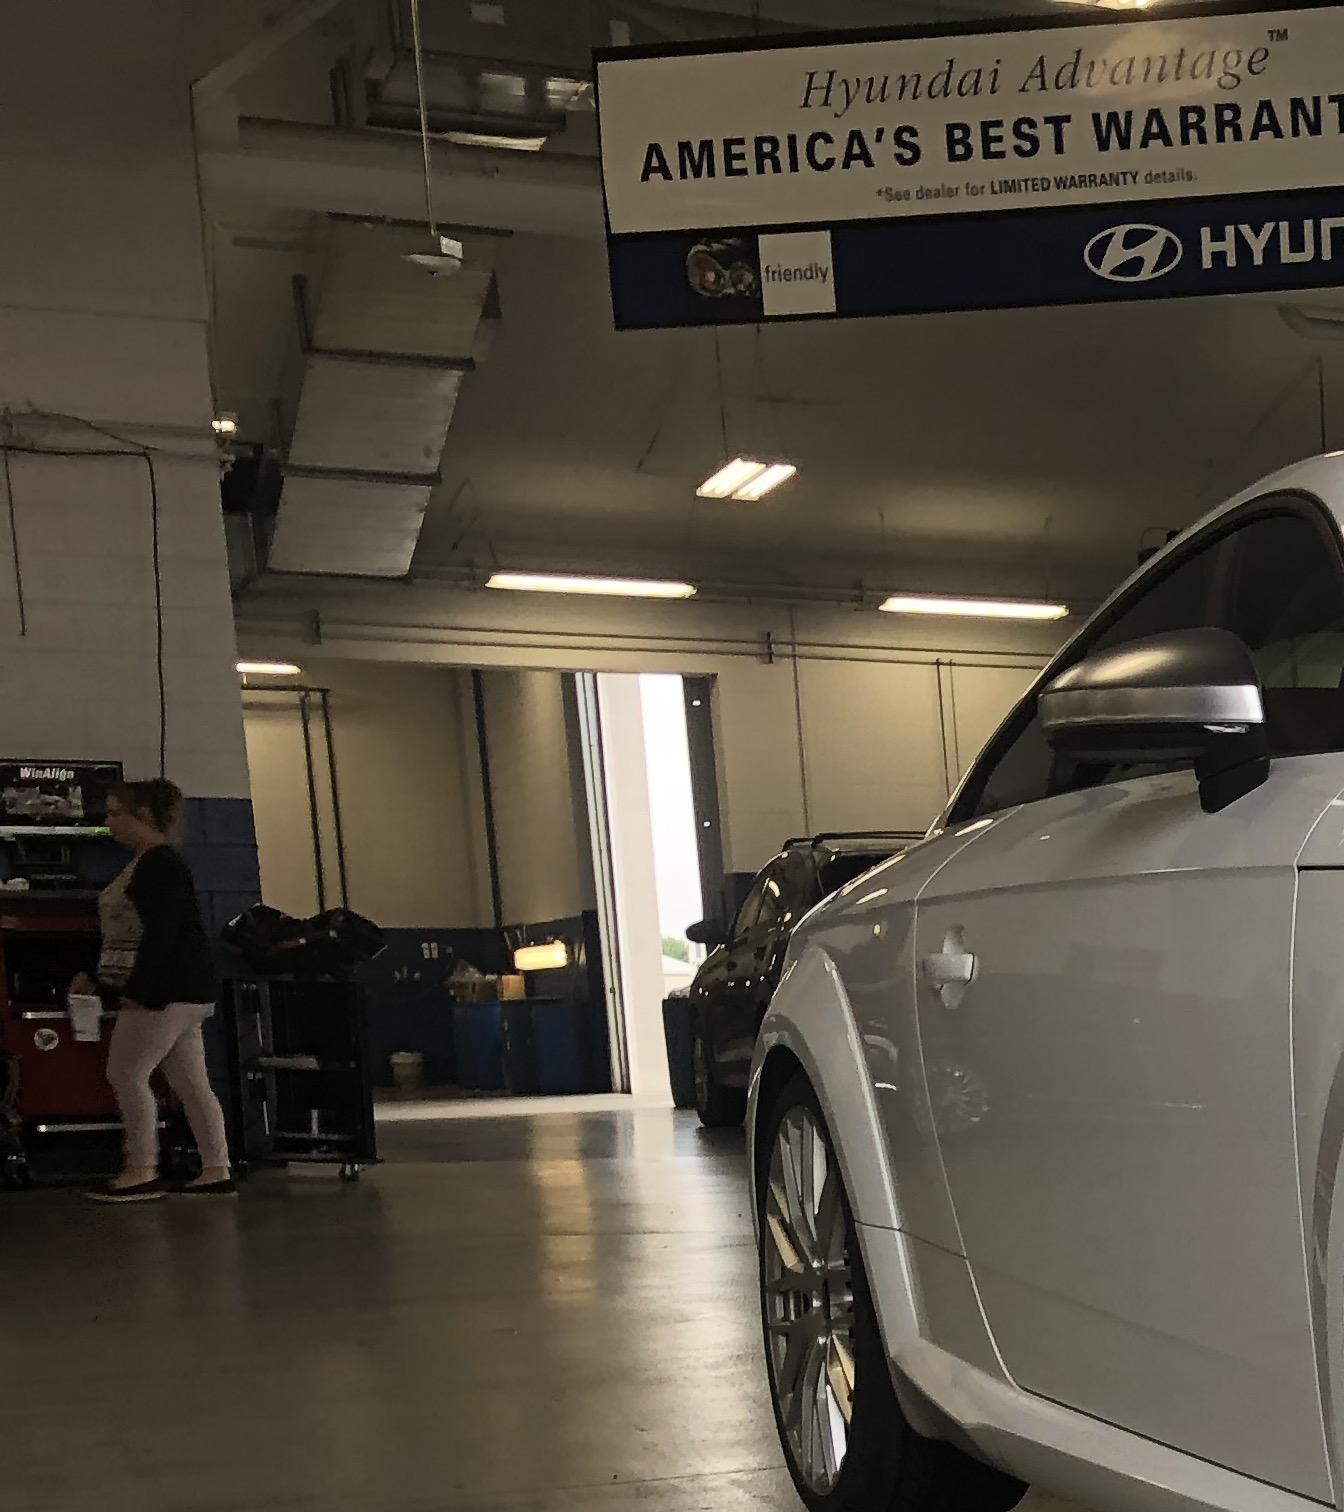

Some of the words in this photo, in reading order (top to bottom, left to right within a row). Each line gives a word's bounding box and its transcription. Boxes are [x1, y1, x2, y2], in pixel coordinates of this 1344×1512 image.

[799, 57, 1001, 118] Hyundai
[1018, 47, 1270, 93] Advantage
[640, 125, 922, 182] AMERICA'S
[945, 114, 1072, 163] BEST
[915, 184, 960, 201] dealer
[965, 181, 986, 198] for
[989, 176, 1051, 196] LIMITED
[1053, 171, 1139, 190] WARRANTY
[1144, 168, 1198, 185] details.
[764, 262, 829, 284] friendly
[20, 767, 75, 781] WinAlign
